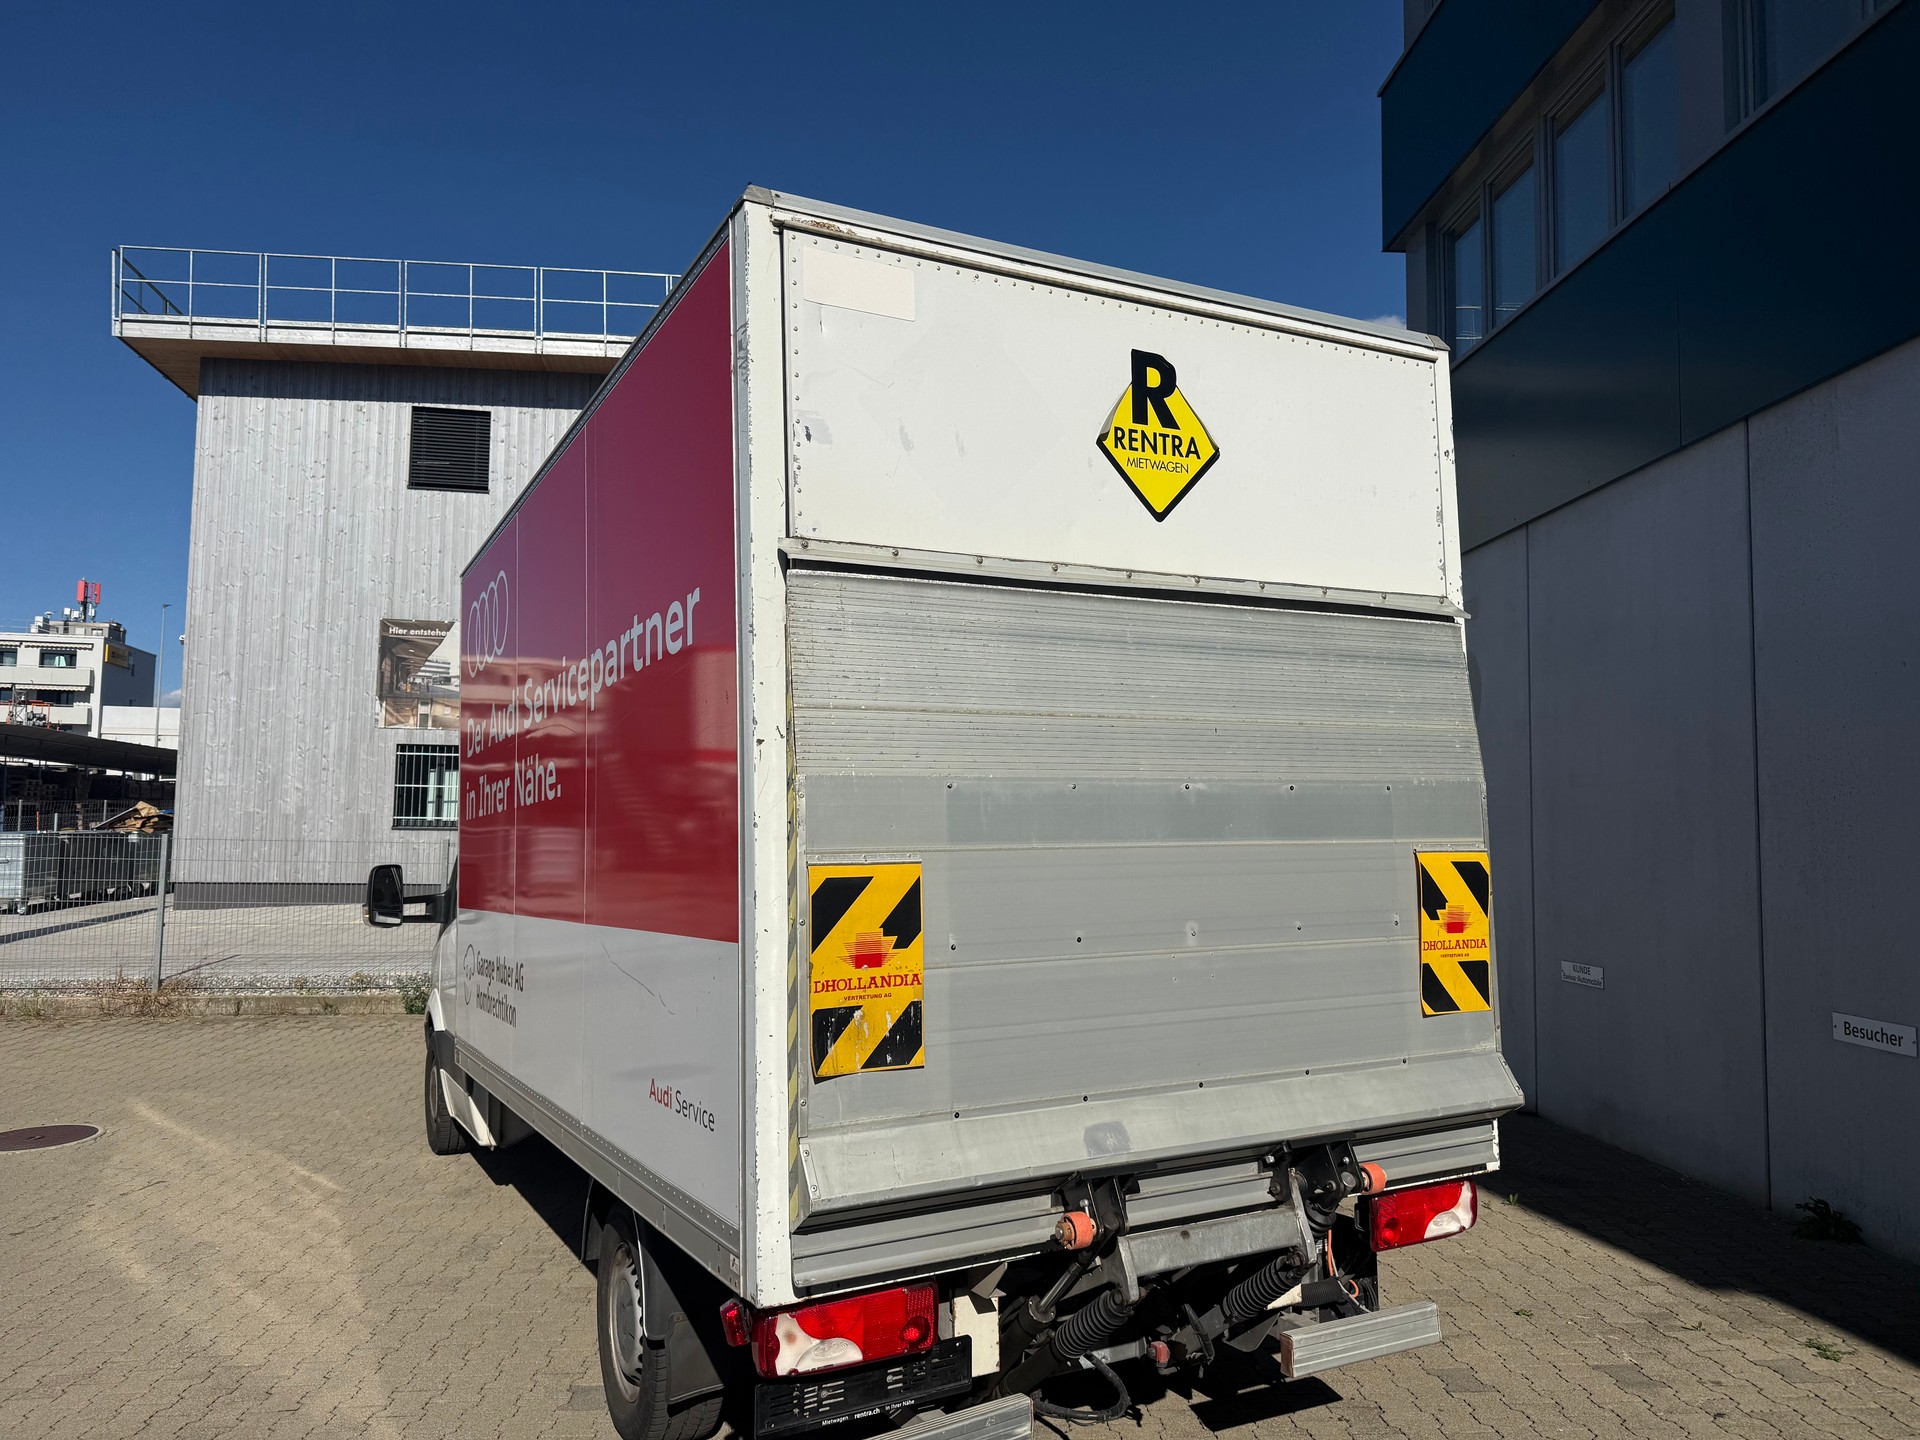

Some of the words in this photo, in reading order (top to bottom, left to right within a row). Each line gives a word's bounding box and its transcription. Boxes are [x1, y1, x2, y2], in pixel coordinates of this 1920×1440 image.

[1131, 349, 1181, 430] R
[1114, 426, 1201, 460] RENTRA
[1126, 457, 1189, 474] MIETWAGEN
[389, 626, 408, 635] Hier
[467, 718, 486, 758] Der
[488, 686, 519, 747] Audi
[523, 587, 701, 729] Servicepartner
[466, 781, 476, 821] in
[478, 774, 510, 817] Ihrer
[514, 753, 562, 808] Nähe.
[1422, 938, 1487, 951] DHOLLANDIA
[476, 950, 495, 986] Garage
[495, 956, 514, 987] Huber
[514, 962, 524, 992] AG
[1573, 963, 1592, 976] KUNDE
[814, 973, 922, 994] DHOLLANDIA
[843, 993, 883, 1001] VERTRETUNG
[476, 984, 517, 1028] Hombrechtikon
[1843, 1021, 1903, 1047] Besucher
[649, 1077, 673, 1110] Audi
[675, 1089, 715, 1132] Service
[822, 1416, 848, 1426] Mietwagen
[854, 1408, 880, 1419] rentra.ch
[902, 1399, 915, 1407] Nähe
